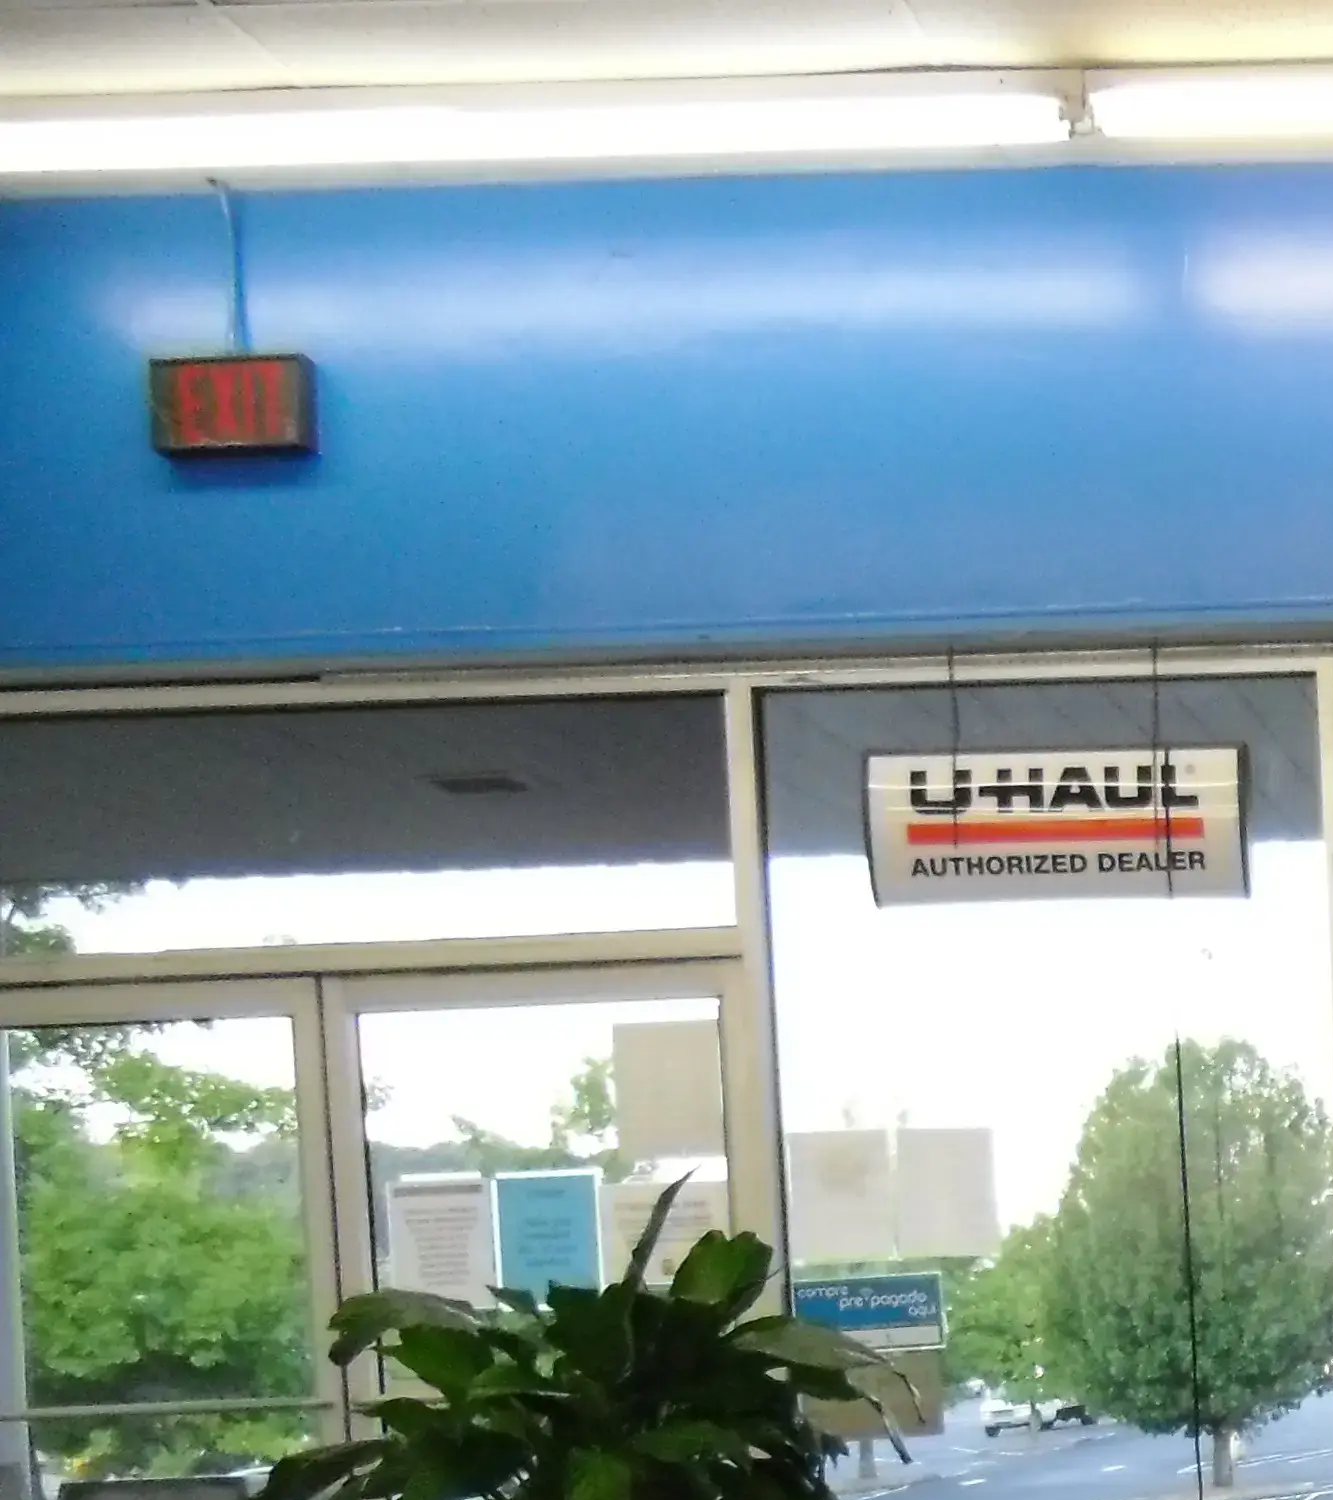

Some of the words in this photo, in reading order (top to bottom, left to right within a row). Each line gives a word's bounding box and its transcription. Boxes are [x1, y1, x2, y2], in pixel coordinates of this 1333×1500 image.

[178, 362, 284, 443] EXIT
[909, 764, 1200, 815] U-HAUL
[910, 852, 1088, 878] AUTHORIZED
[1097, 851, 1206, 874] DEALER
[796, 1285, 849, 1299] compre
